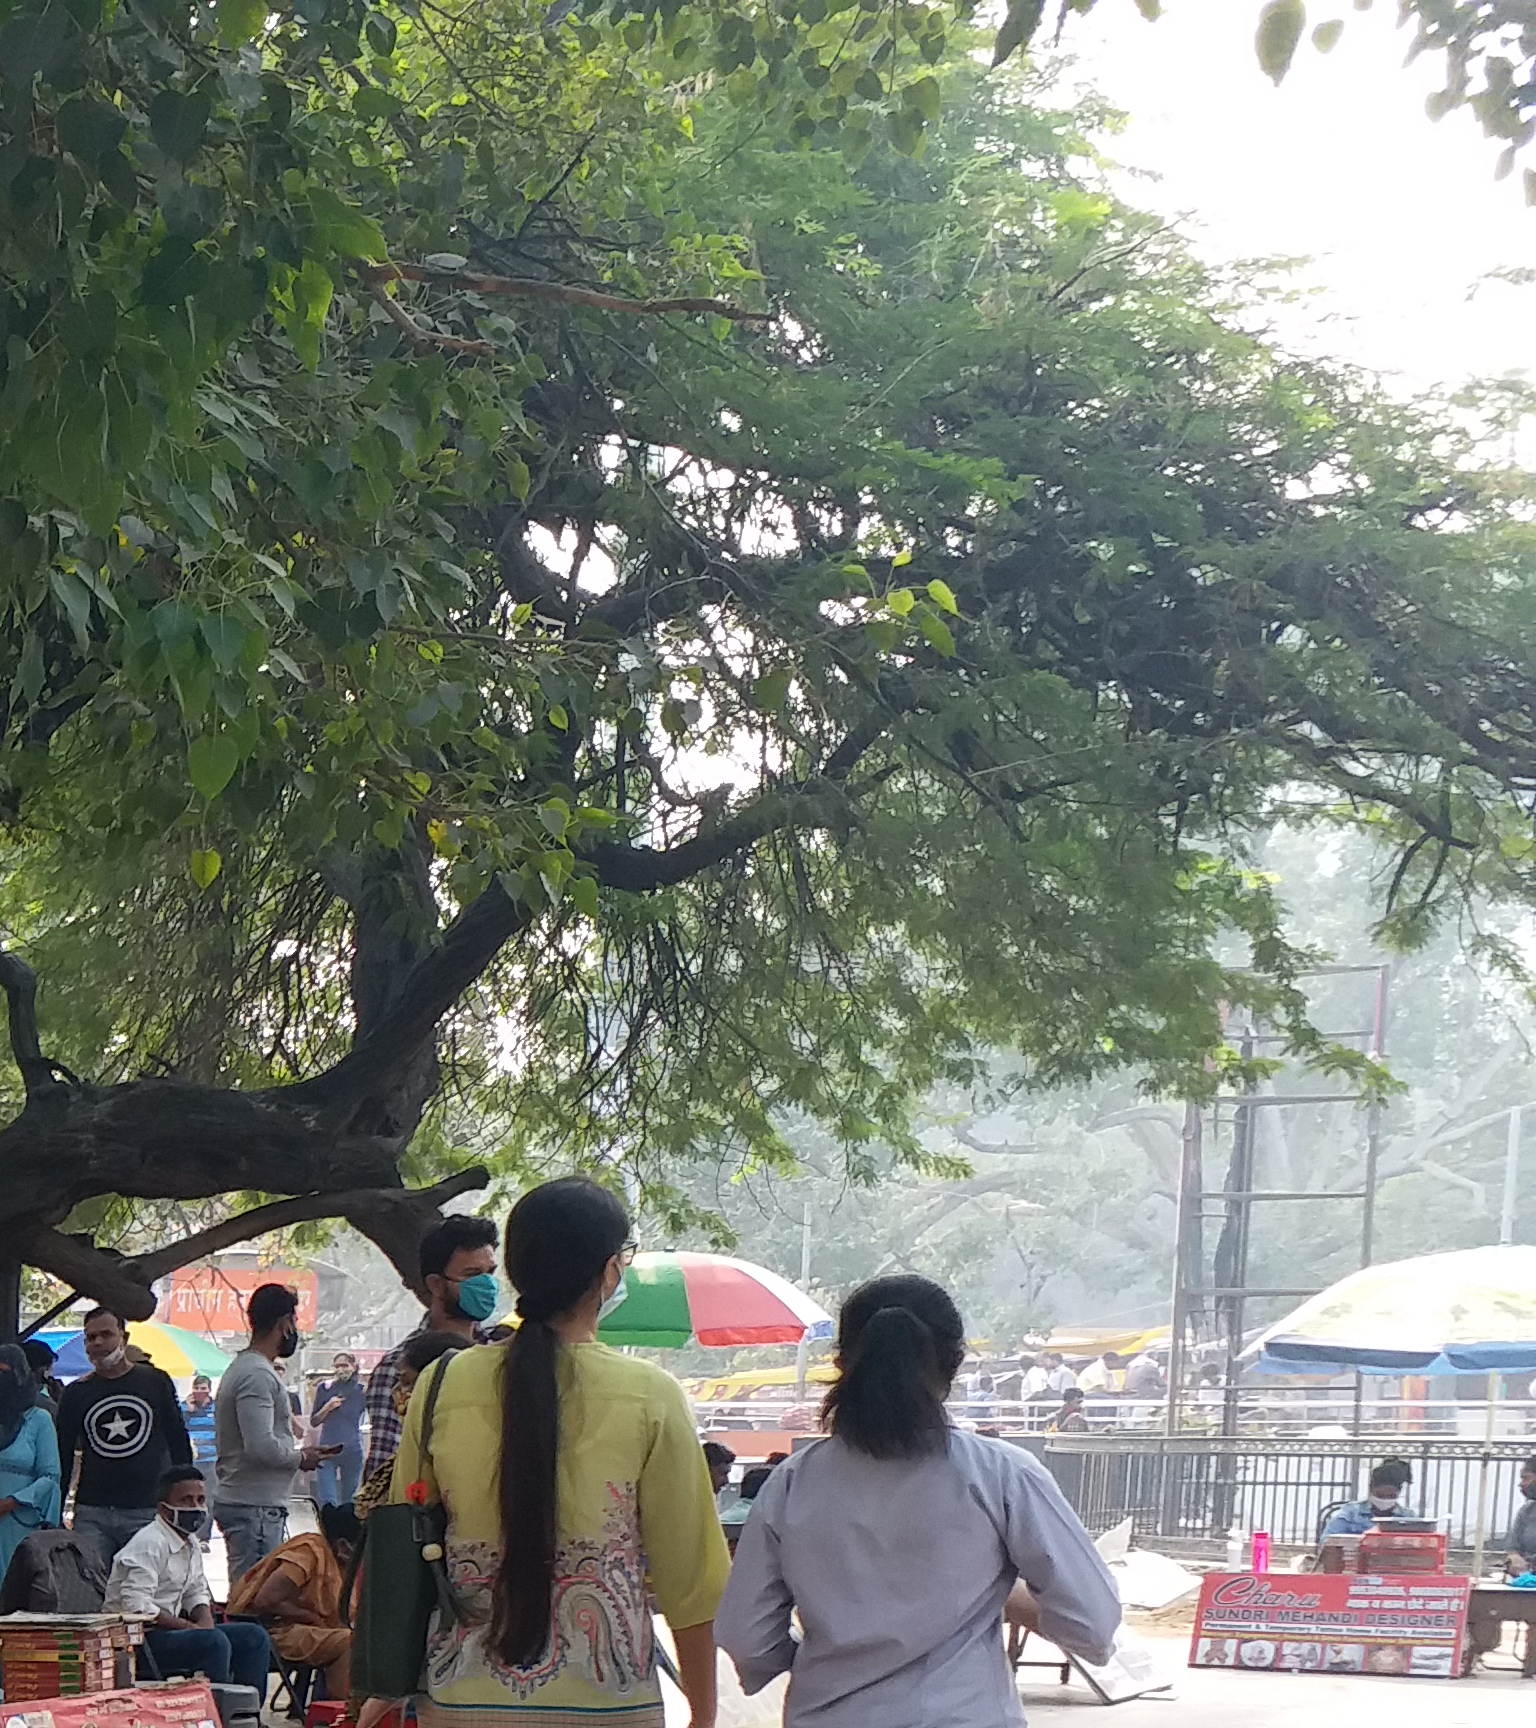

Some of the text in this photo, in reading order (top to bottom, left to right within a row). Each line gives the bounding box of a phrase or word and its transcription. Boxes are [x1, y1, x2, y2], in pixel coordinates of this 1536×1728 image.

[1213, 1576, 1322, 1608] Charu
[1204, 1608, 1458, 1628] SUNDRI MEHANDI DESIGNER
